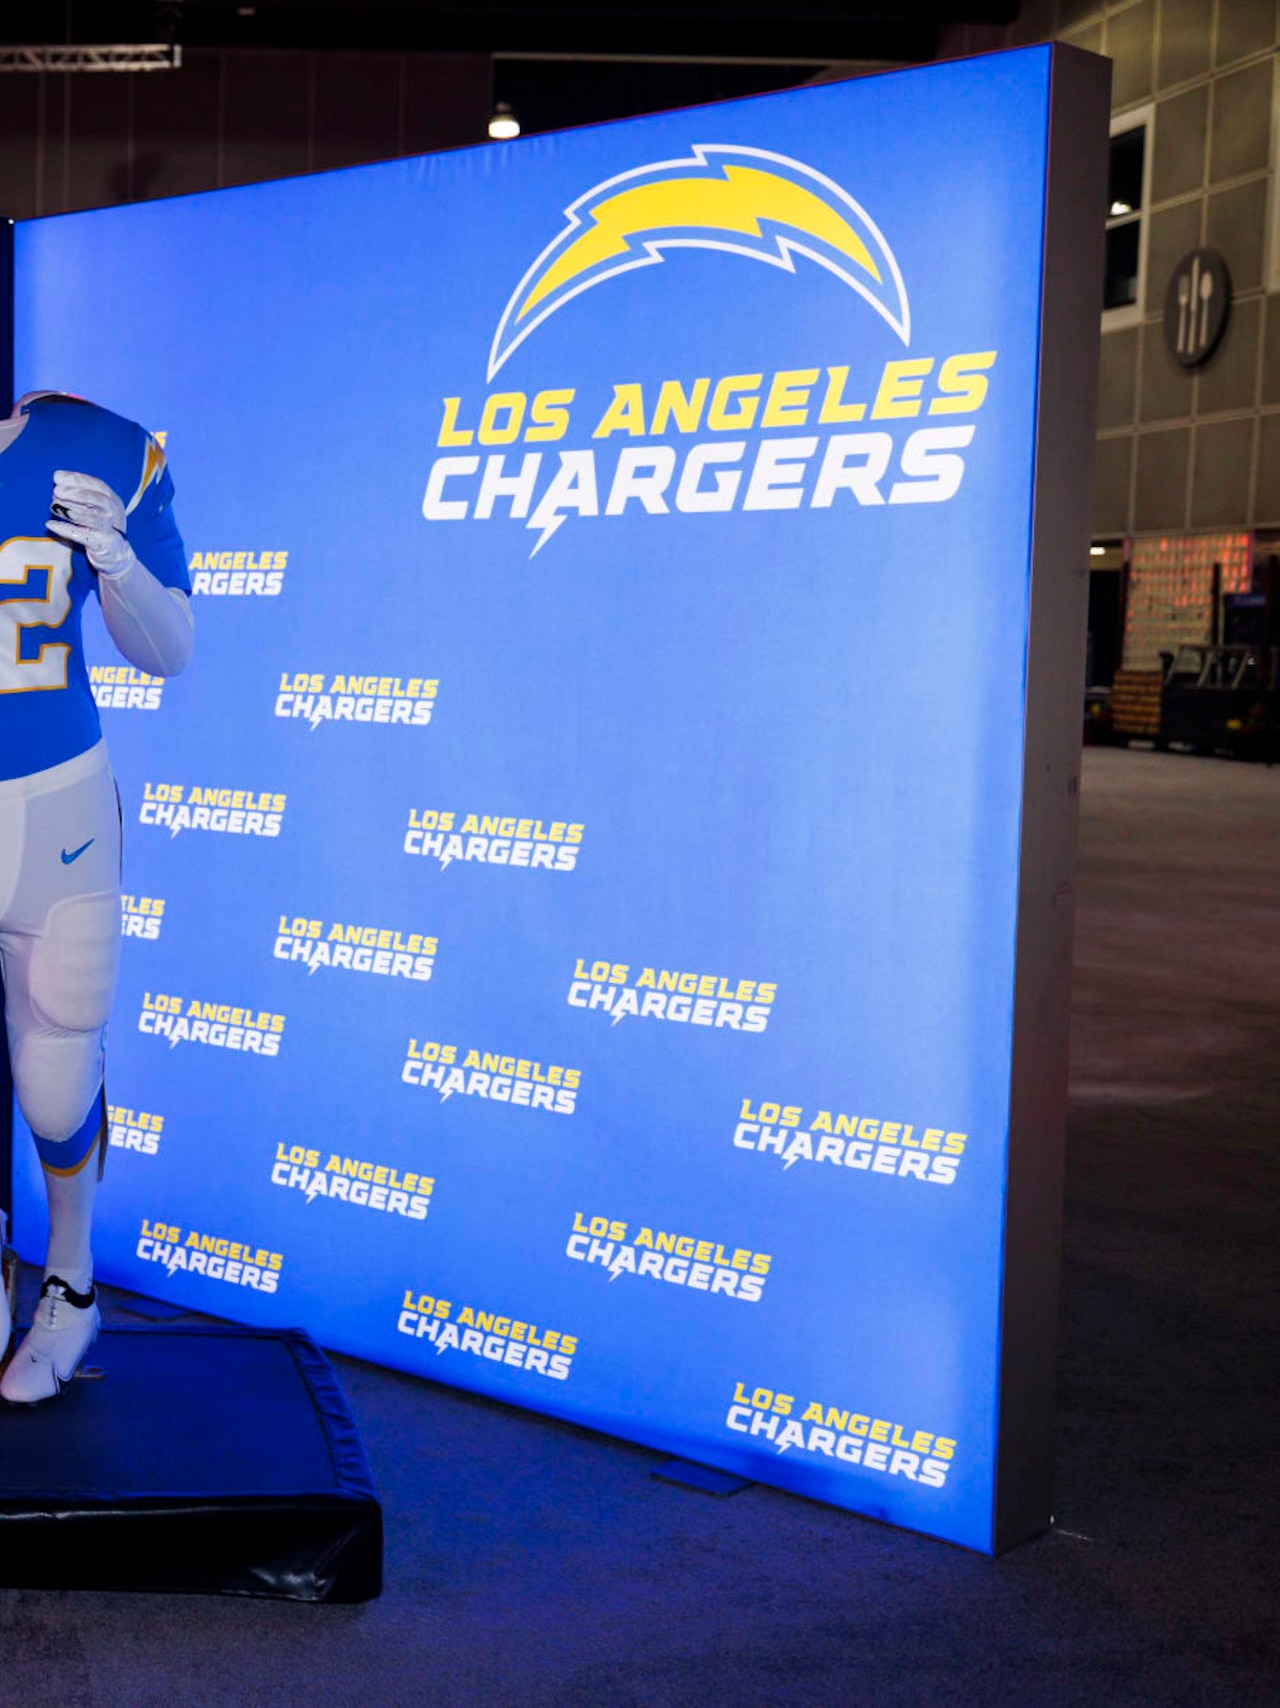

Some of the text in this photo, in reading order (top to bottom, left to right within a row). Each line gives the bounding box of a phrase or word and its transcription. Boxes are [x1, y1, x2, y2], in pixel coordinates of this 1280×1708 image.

[437, 351, 997, 447] LOS ANGELES
[422, 425, 977, 558] CHARGERS
[189, 551, 288, 571] ANGELES
[192, 571, 284, 596] RGERS
[90, 685, 162, 710] GERS
[280, 673, 439, 699] LOS ANGELES
[275, 693, 434, 730] CHARGERS
[139, 802, 282, 837] CHARGERS
[143, 783, 287, 813] LOS ANGELES
[404, 830, 579, 871] CHARGERS
[408, 808, 585, 844] LOS ANGELES
[274, 936, 434, 981] CHARGERS
[278, 915, 438, 956] LOS ANGELES
[574, 959, 778, 1004] LOS ANGELES
[143, 992, 285, 1033] LOS ANGELES
[567, 981, 771, 1033] CHARGERS
[139, 1011, 281, 1056] CHARGERS
[402, 1060, 576, 1114] CHARGERS
[407, 1039, 581, 1089] LOS ANGELES
[740, 1099, 968, 1155] LOS ANGELES
[276, 1143, 434, 1195] LOS ANGELES
[733, 1123, 960, 1184] CHARGERS
[272, 1162, 429, 1219] CHARGERS
[138, 1239, 279, 1292] CHARGERS
[142, 1220, 282, 1270] LOS ANGELES
[567, 1234, 765, 1301] CHARGERS
[573, 1213, 771, 1274] LOS ANGELES
[398, 1311, 571, 1379] CHARGERS
[404, 1291, 577, 1354] LOS ANGELES
[734, 1383, 956, 1459] LOS ANGELES
[727, 1406, 949, 1487] CHARGERS
